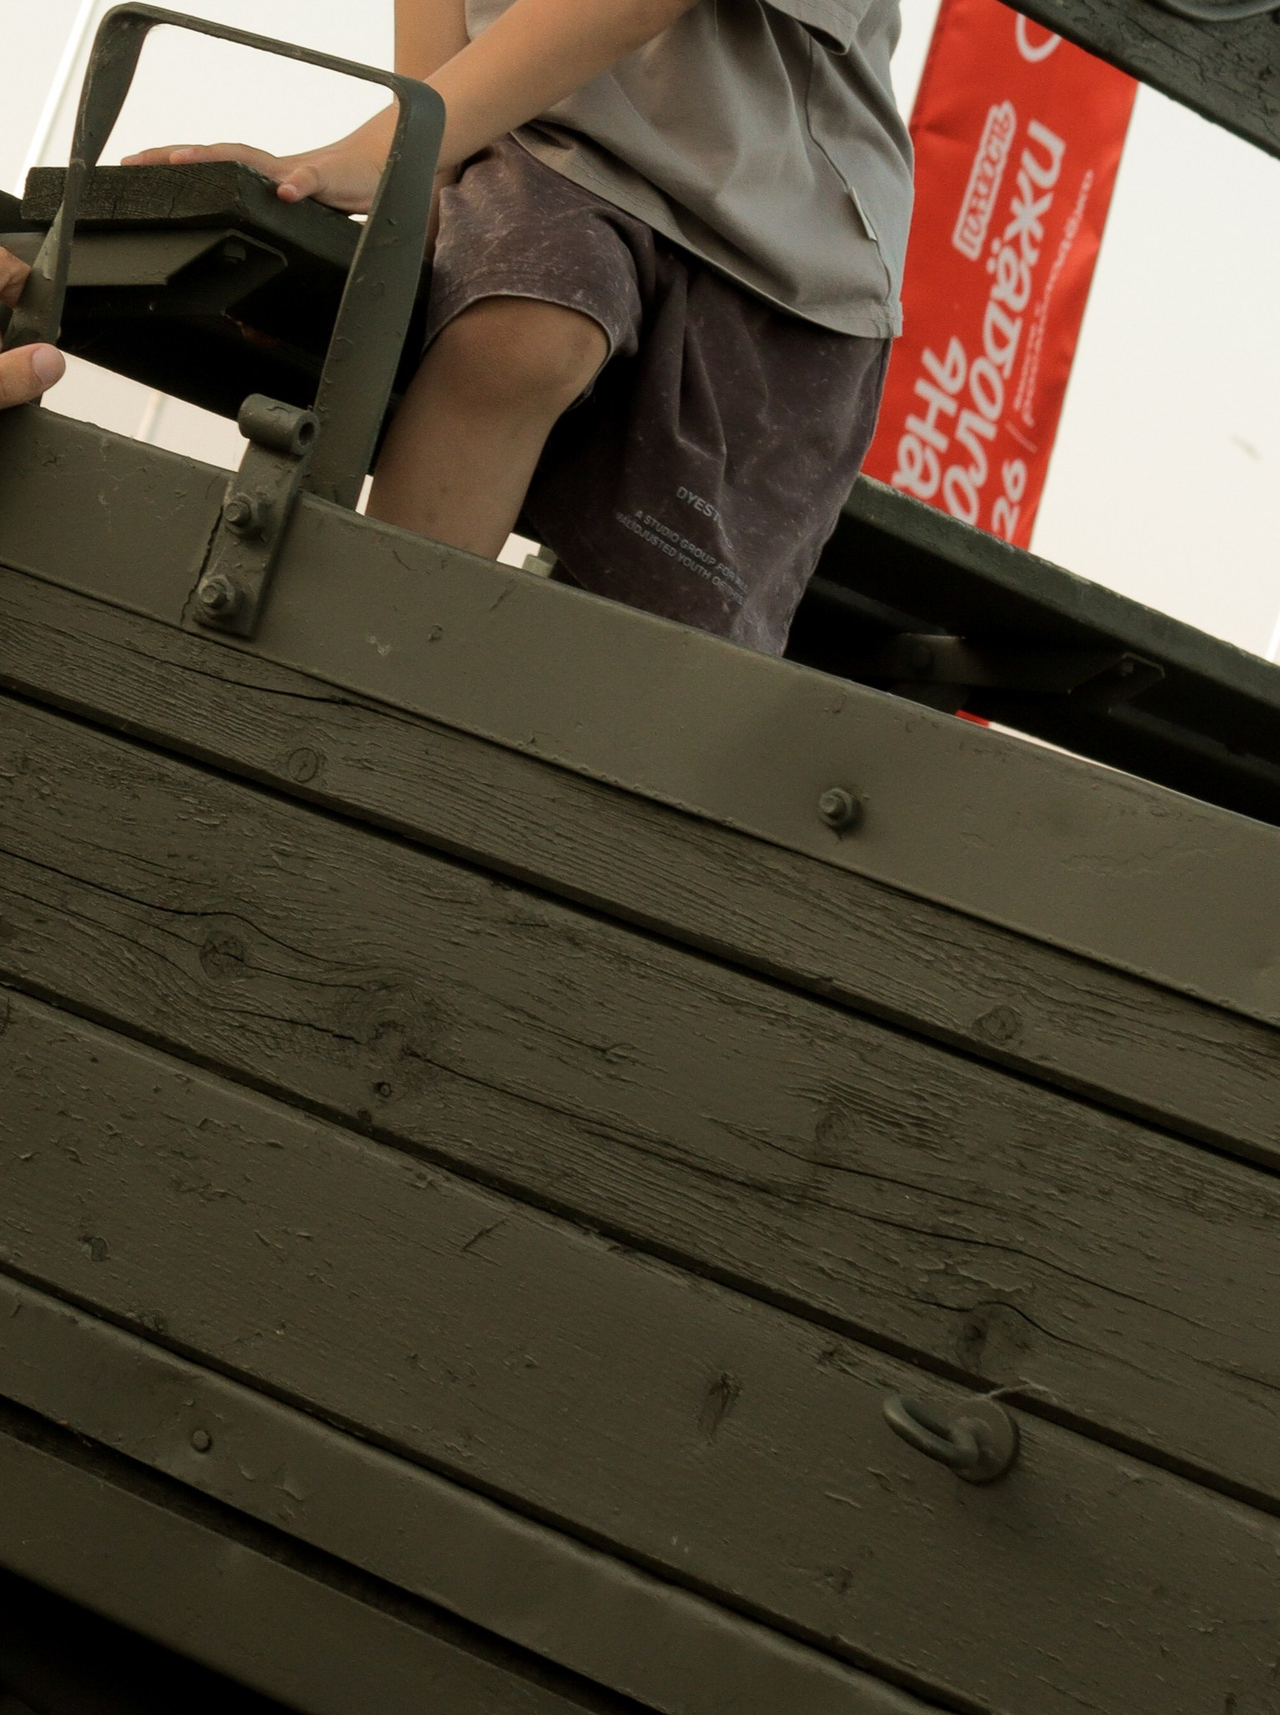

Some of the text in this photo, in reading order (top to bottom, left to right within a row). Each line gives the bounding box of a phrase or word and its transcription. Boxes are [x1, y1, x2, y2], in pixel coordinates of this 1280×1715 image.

[941, 119, 1067, 526] олодёжи
[891, 334, 968, 501] ень
[634, 509, 644, 520] A
[679, 538, 717, 566] GROUP
[677, 553, 711, 580] YOUTH
